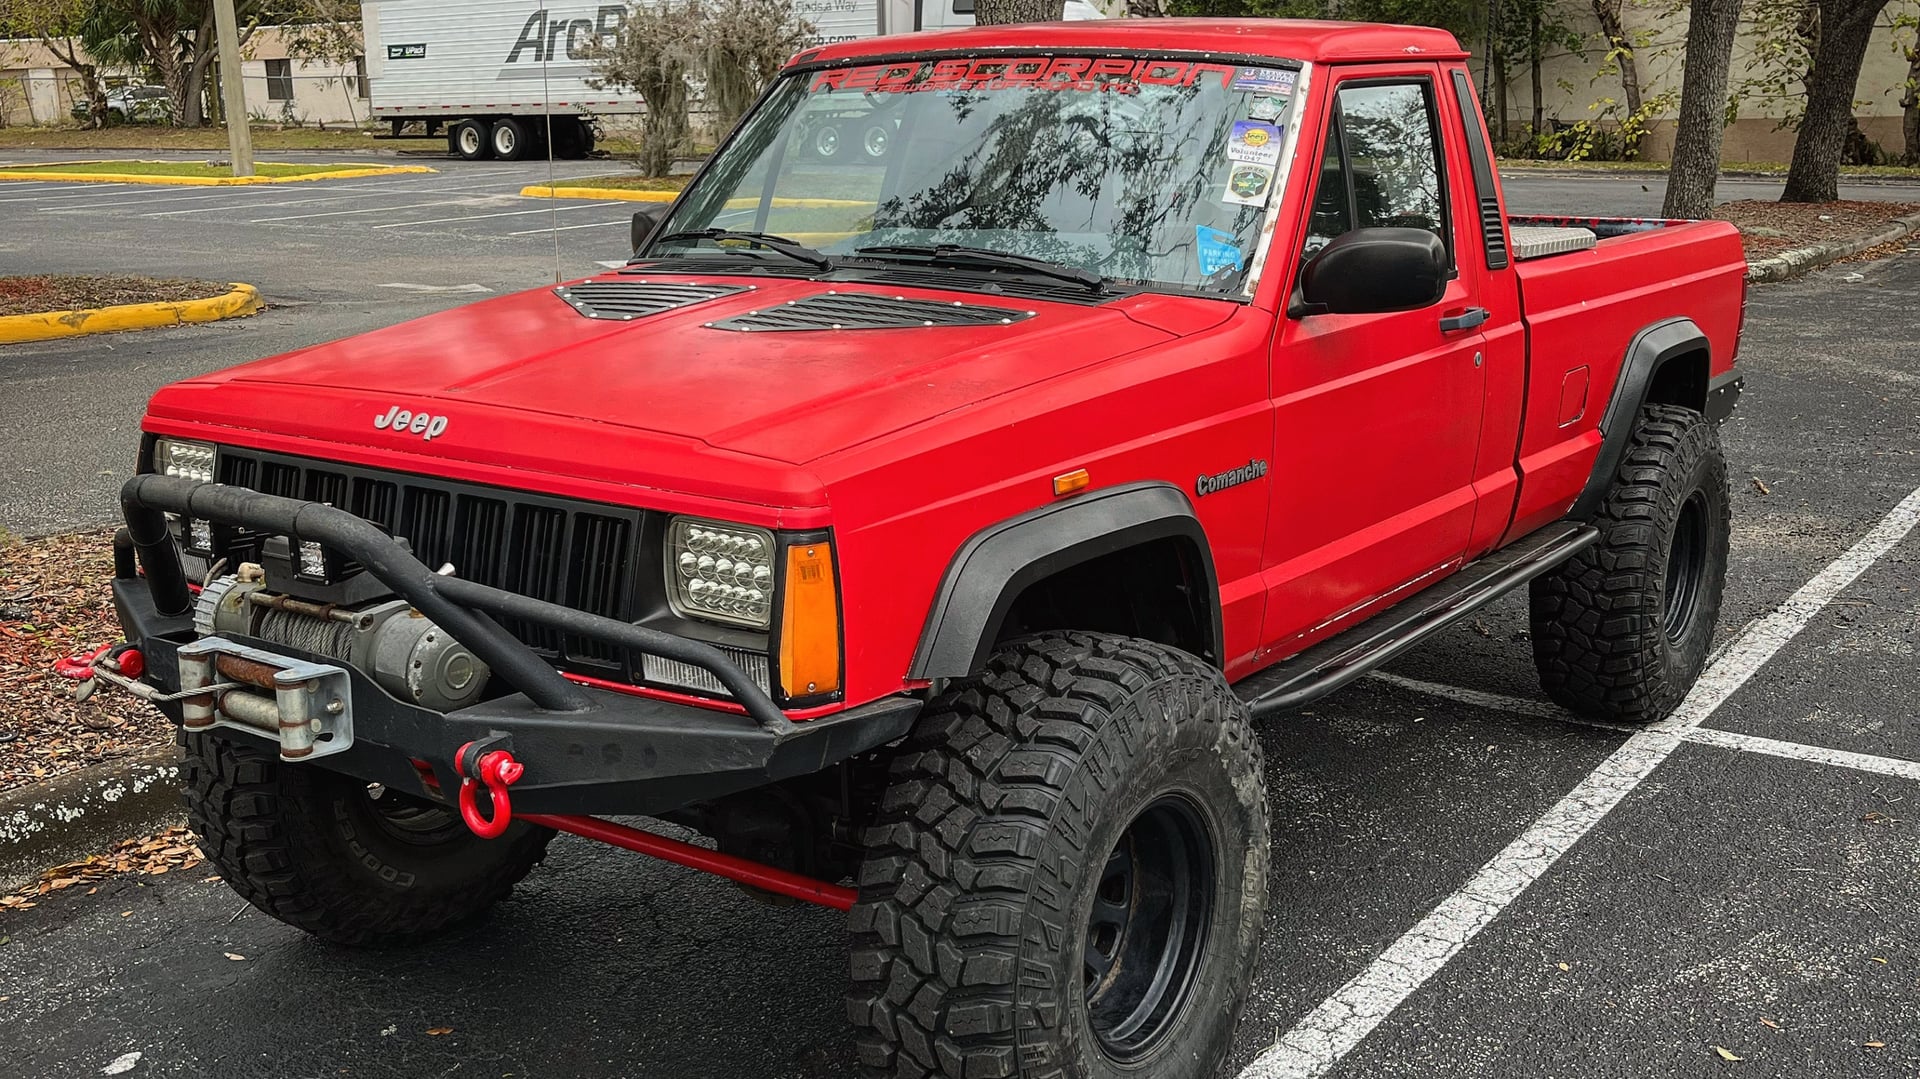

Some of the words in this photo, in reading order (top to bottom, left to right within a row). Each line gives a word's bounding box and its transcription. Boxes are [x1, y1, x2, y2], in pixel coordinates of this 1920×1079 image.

[835, 0, 857, 12] Way
[811, 61, 921, 93] RED
[929, 57, 1236, 91] SCORPION
[864, 81, 973, 95] FABWORKS
[989, 80, 1095, 92] OFFROAD
[1231, 147, 1273, 159] Volunteer
[374, 406, 448, 441] Jeep
[1197, 458, 1268, 497] Comanche
[333, 797, 417, 888] COOPER
